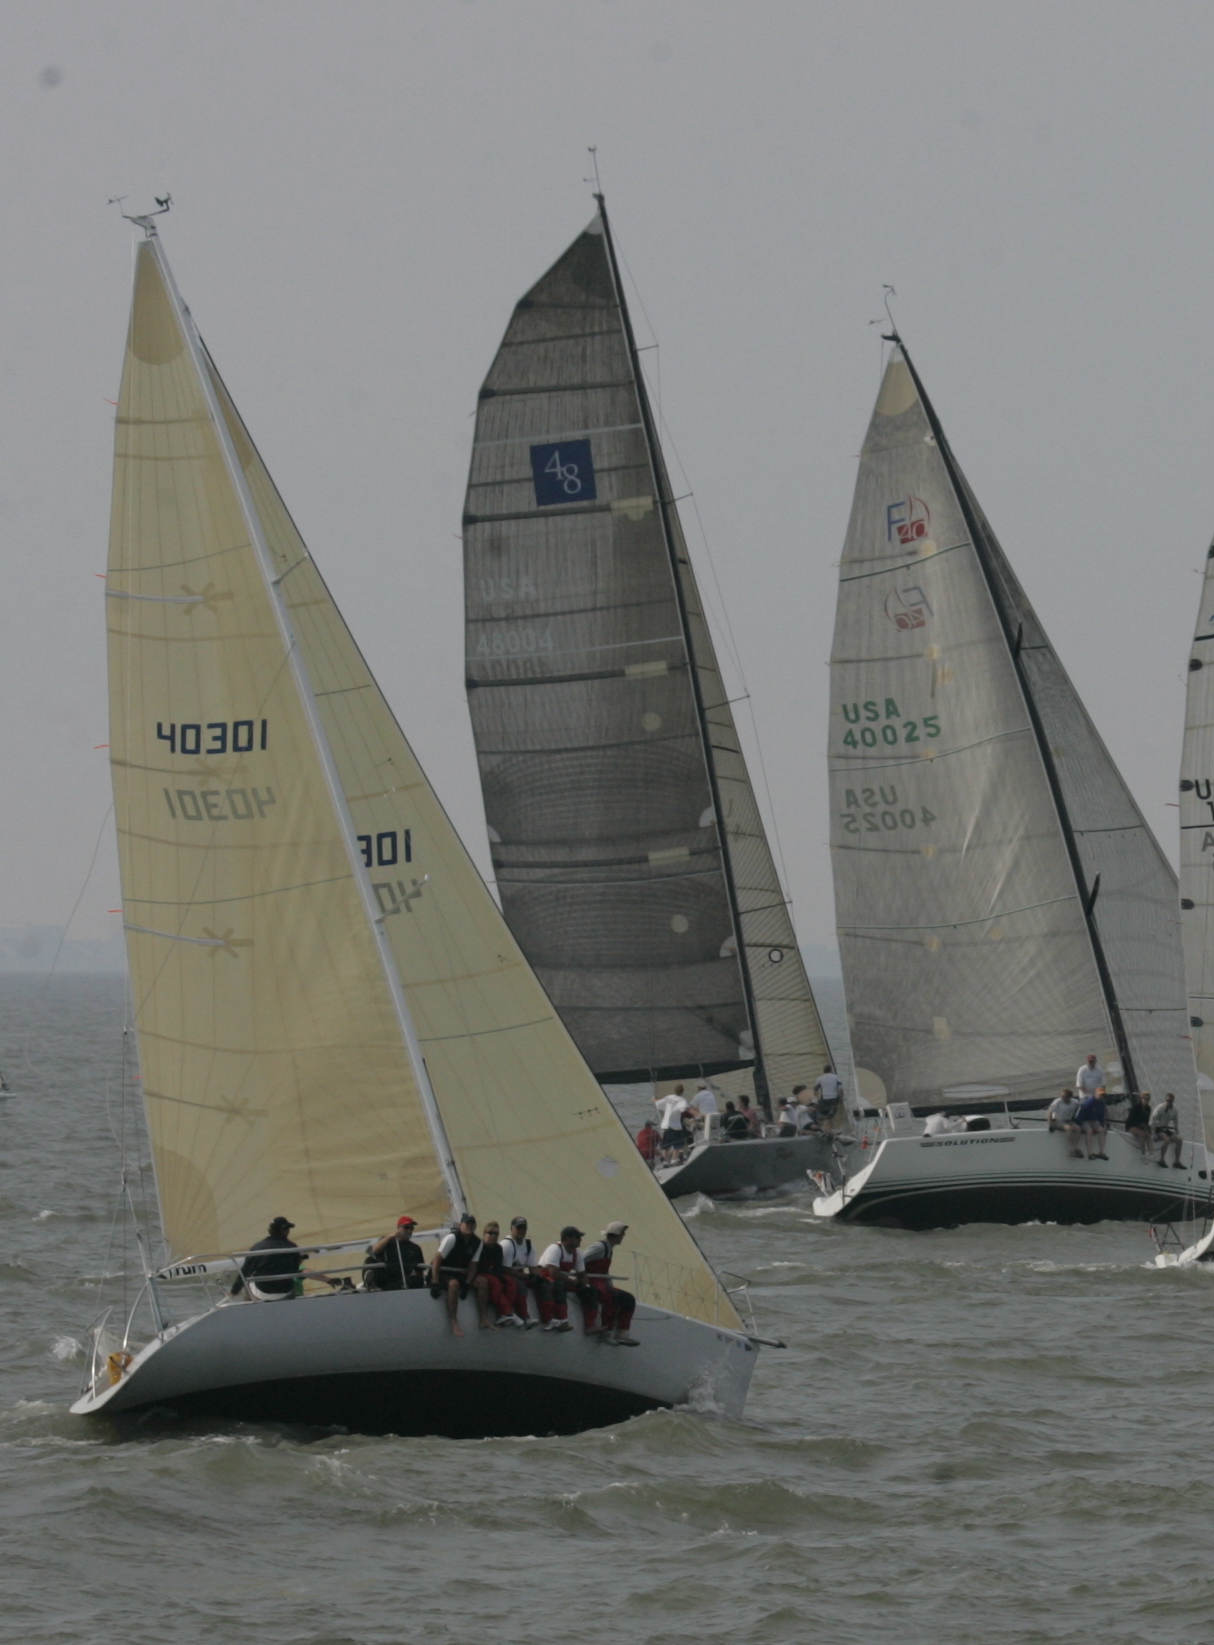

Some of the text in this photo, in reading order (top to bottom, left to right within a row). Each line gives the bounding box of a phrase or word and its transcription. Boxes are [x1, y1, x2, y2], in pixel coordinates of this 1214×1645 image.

[543, 450, 582, 495] 48
[842, 698, 900, 723] USA
[156, 719, 267, 754] 40301
[843, 715, 941, 749] 40025
